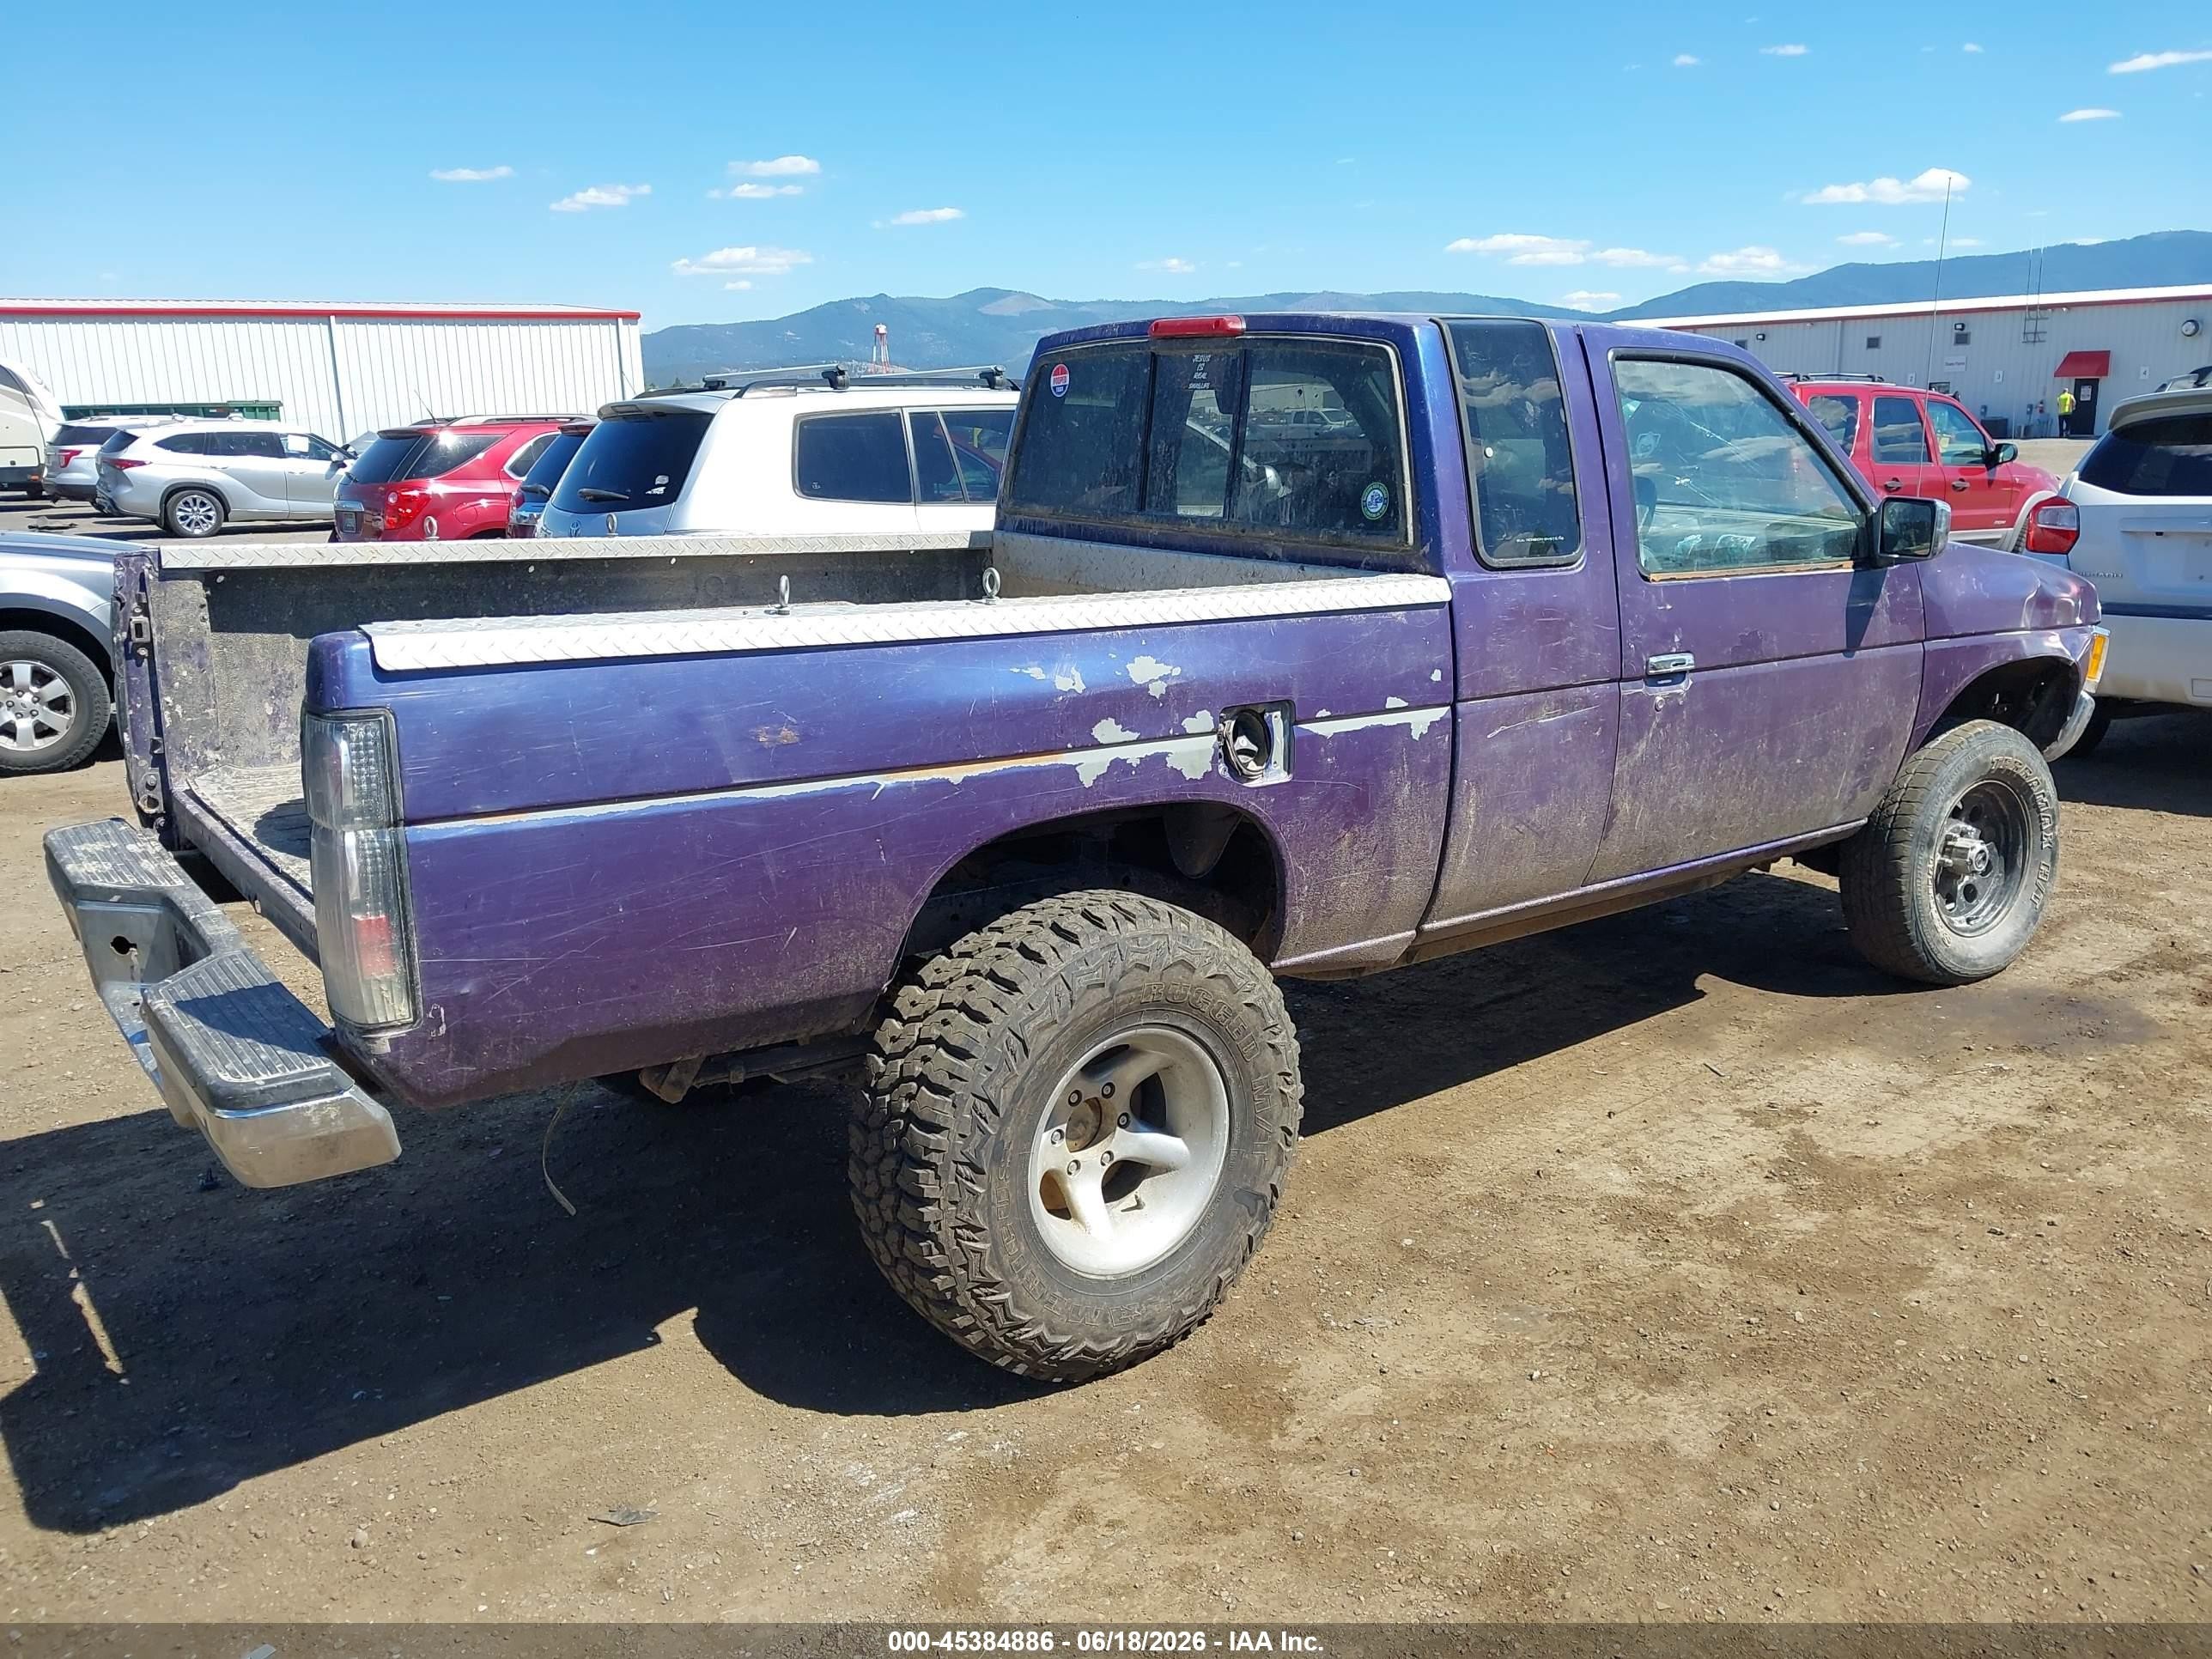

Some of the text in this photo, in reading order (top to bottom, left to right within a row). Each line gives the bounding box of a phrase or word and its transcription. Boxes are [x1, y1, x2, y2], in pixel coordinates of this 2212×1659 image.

[1193, 354, 1211, 362] JESUS
[1197, 362, 1206, 371] IS
[1140, 981, 1274, 1162] RUGGED M/T
